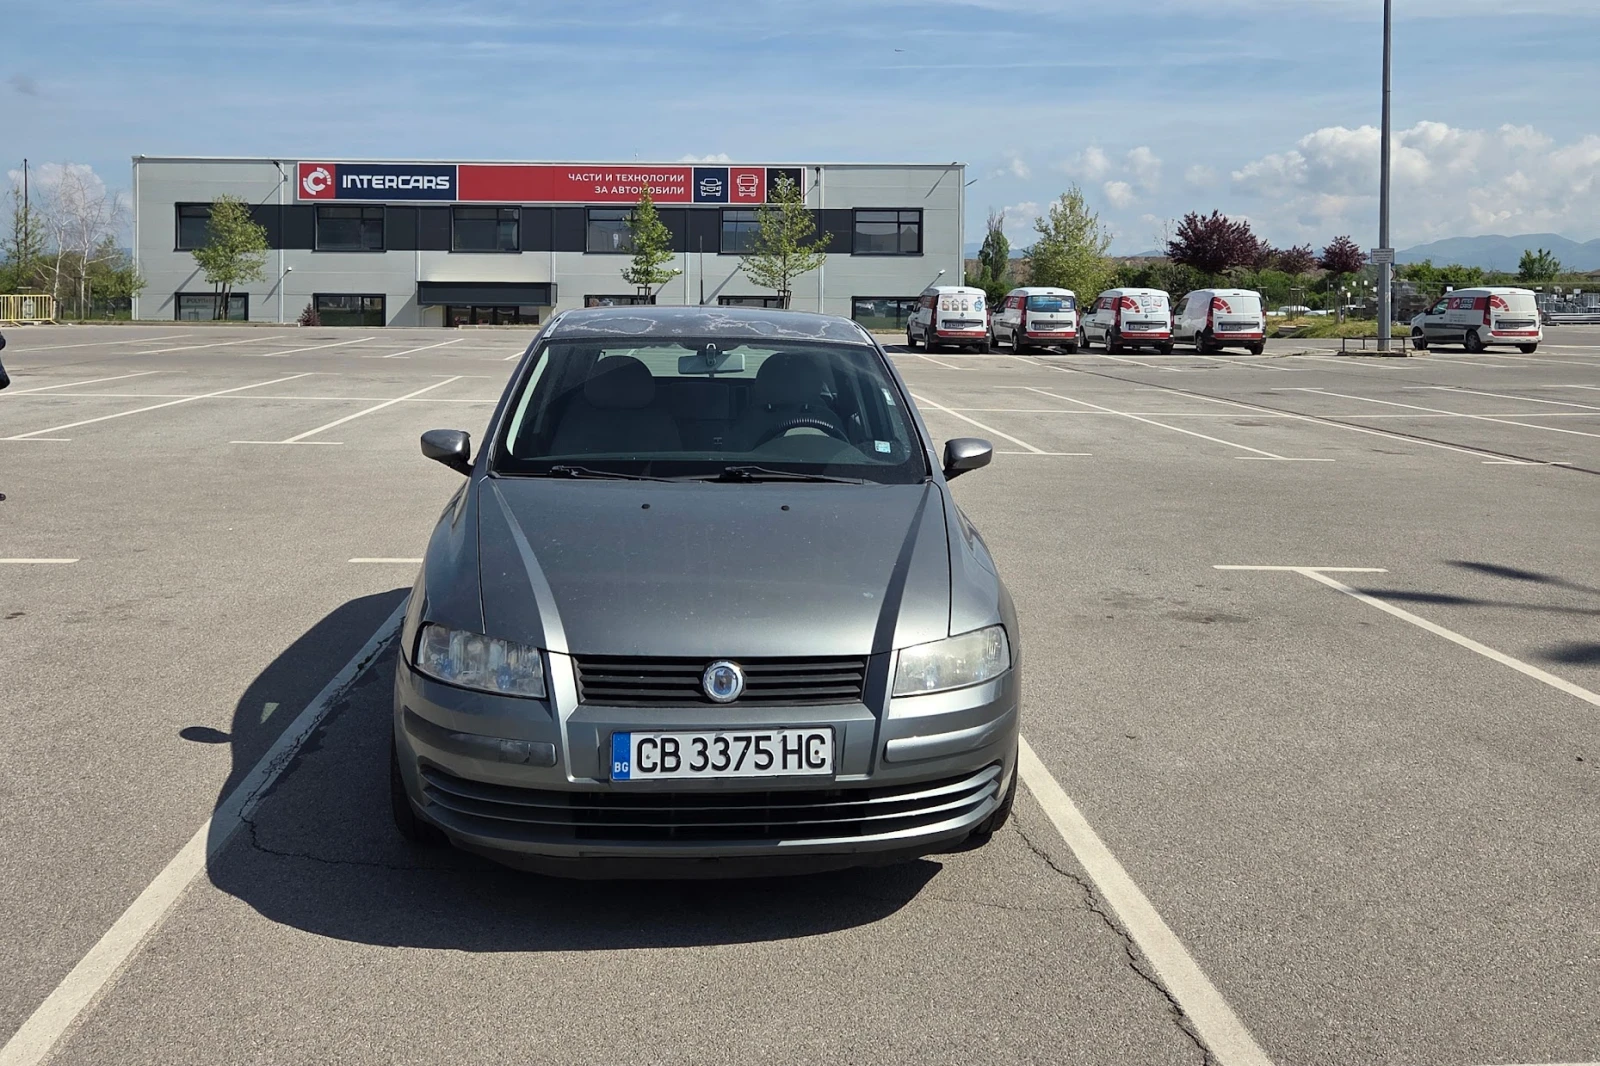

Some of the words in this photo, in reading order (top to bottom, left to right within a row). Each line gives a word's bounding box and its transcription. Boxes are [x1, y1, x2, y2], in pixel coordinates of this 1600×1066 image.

[342, 174, 450, 190] INTERCARS
[568, 173, 602, 182] ЧАСТИ
[605, 174, 613, 182] И
[615, 174, 685, 183] ТЕХНОЛОГИИ
[594, 186, 608, 194] ЗА
[614, 762, 629, 772] BG
[637, 737, 681, 773] CB
[689, 735, 774, 772] 3375
[782, 734, 826, 770] HC
